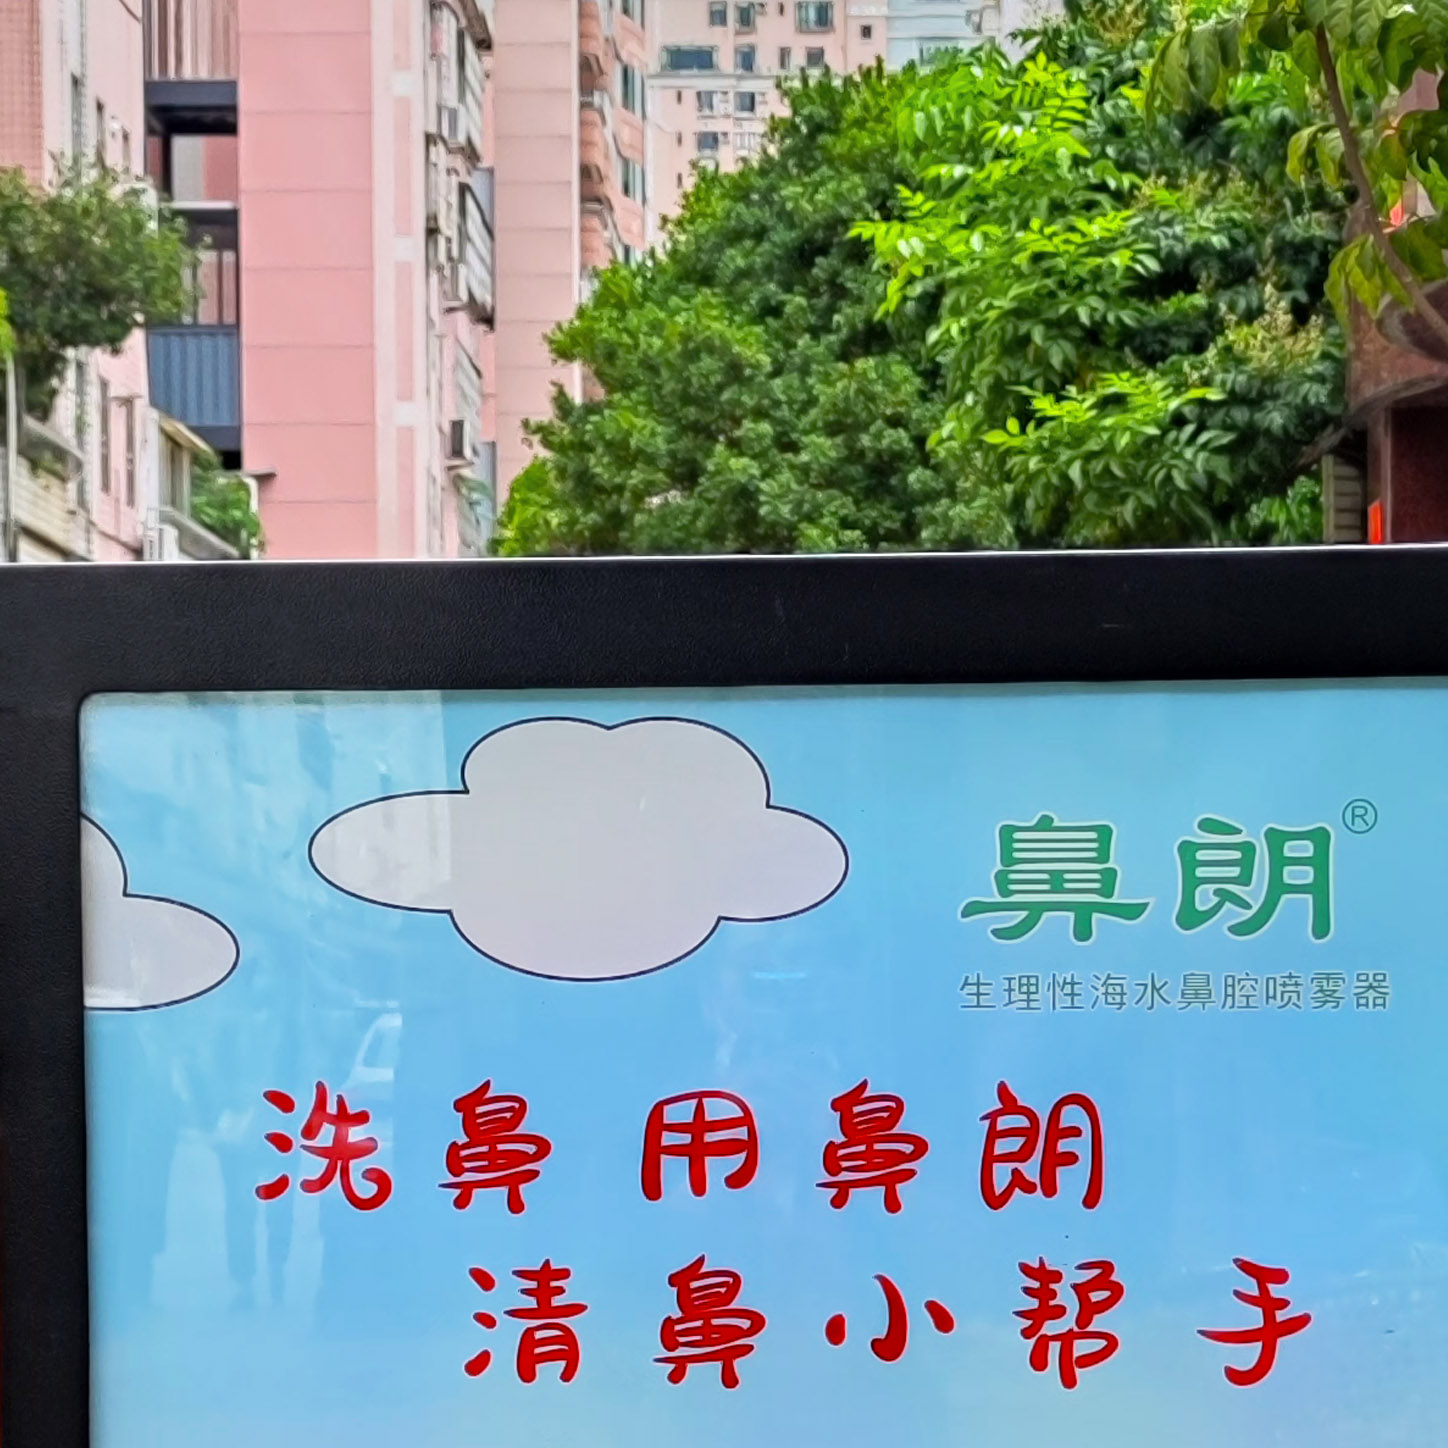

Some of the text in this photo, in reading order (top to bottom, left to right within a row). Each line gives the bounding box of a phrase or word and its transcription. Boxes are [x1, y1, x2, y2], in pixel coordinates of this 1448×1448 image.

[960, 972, 1390, 1011] 生理性海水鼻腔喷雾器
[256, 1081, 1102, 1212] 洗鼻用鼻朗
[465, 1255, 1310, 1388] 清鼻小帮手
